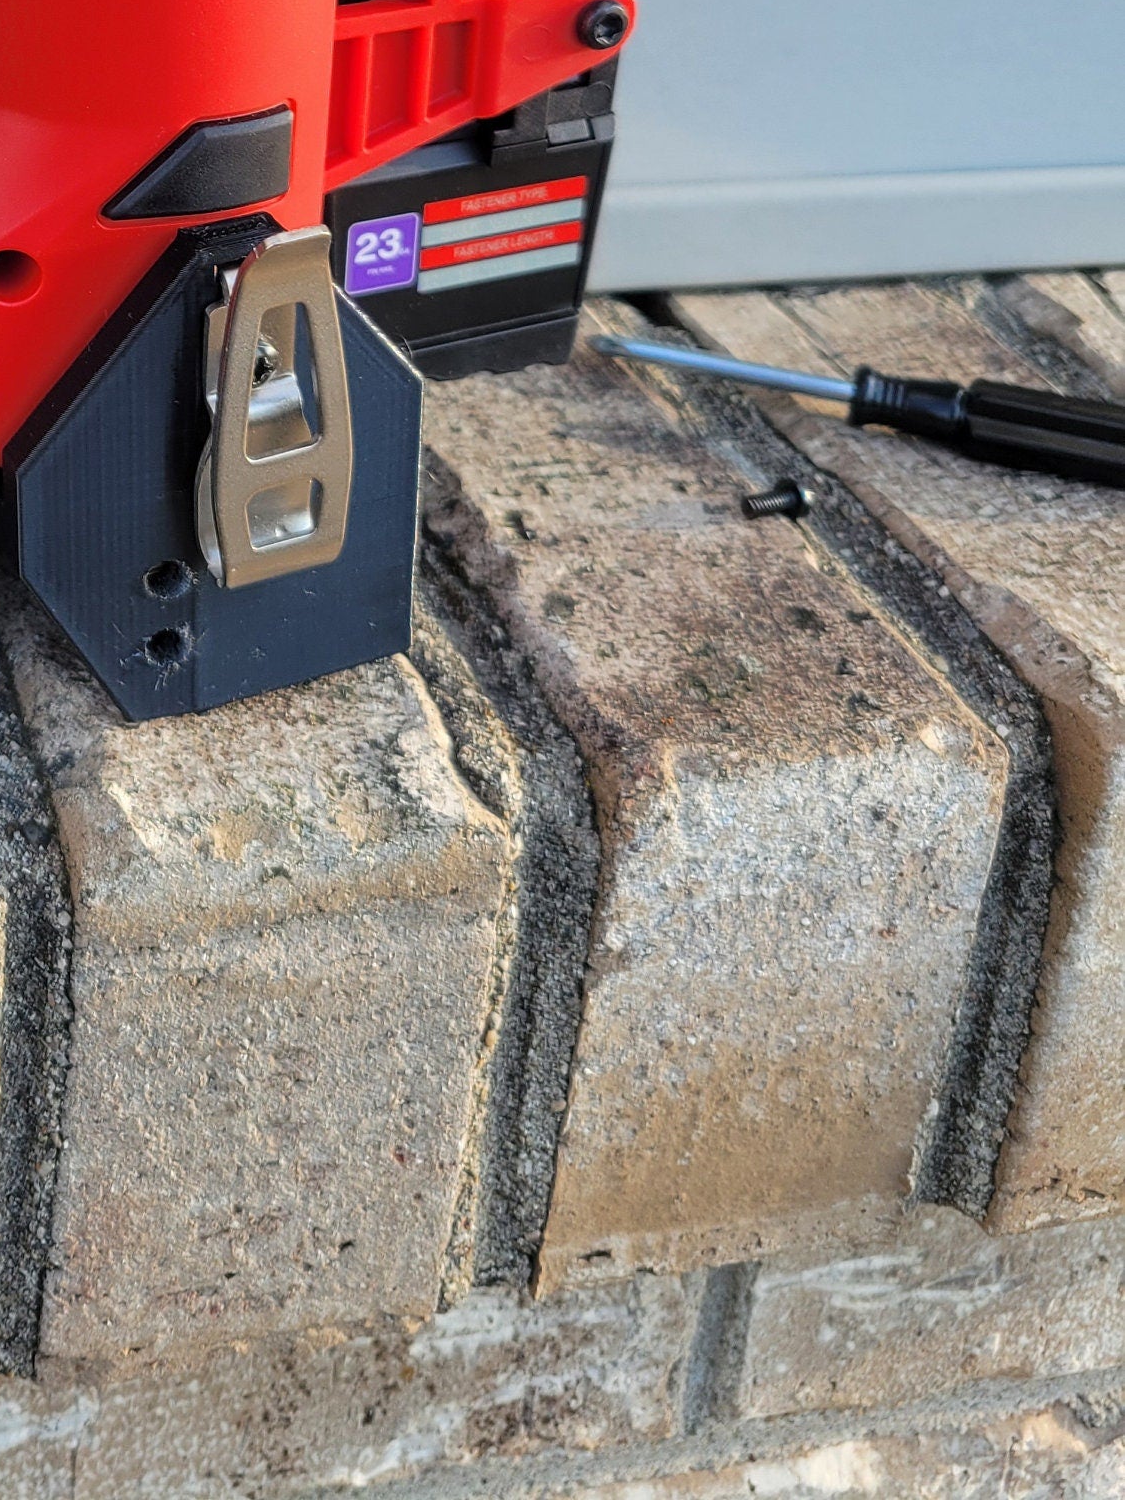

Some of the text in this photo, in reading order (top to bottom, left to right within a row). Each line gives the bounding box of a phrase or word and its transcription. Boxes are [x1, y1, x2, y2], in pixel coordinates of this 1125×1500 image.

[461, 186, 549, 212] FASTENER TYPE
[354, 227, 401, 264] 23
[453, 230, 555, 258] FASTENER LENGTH
